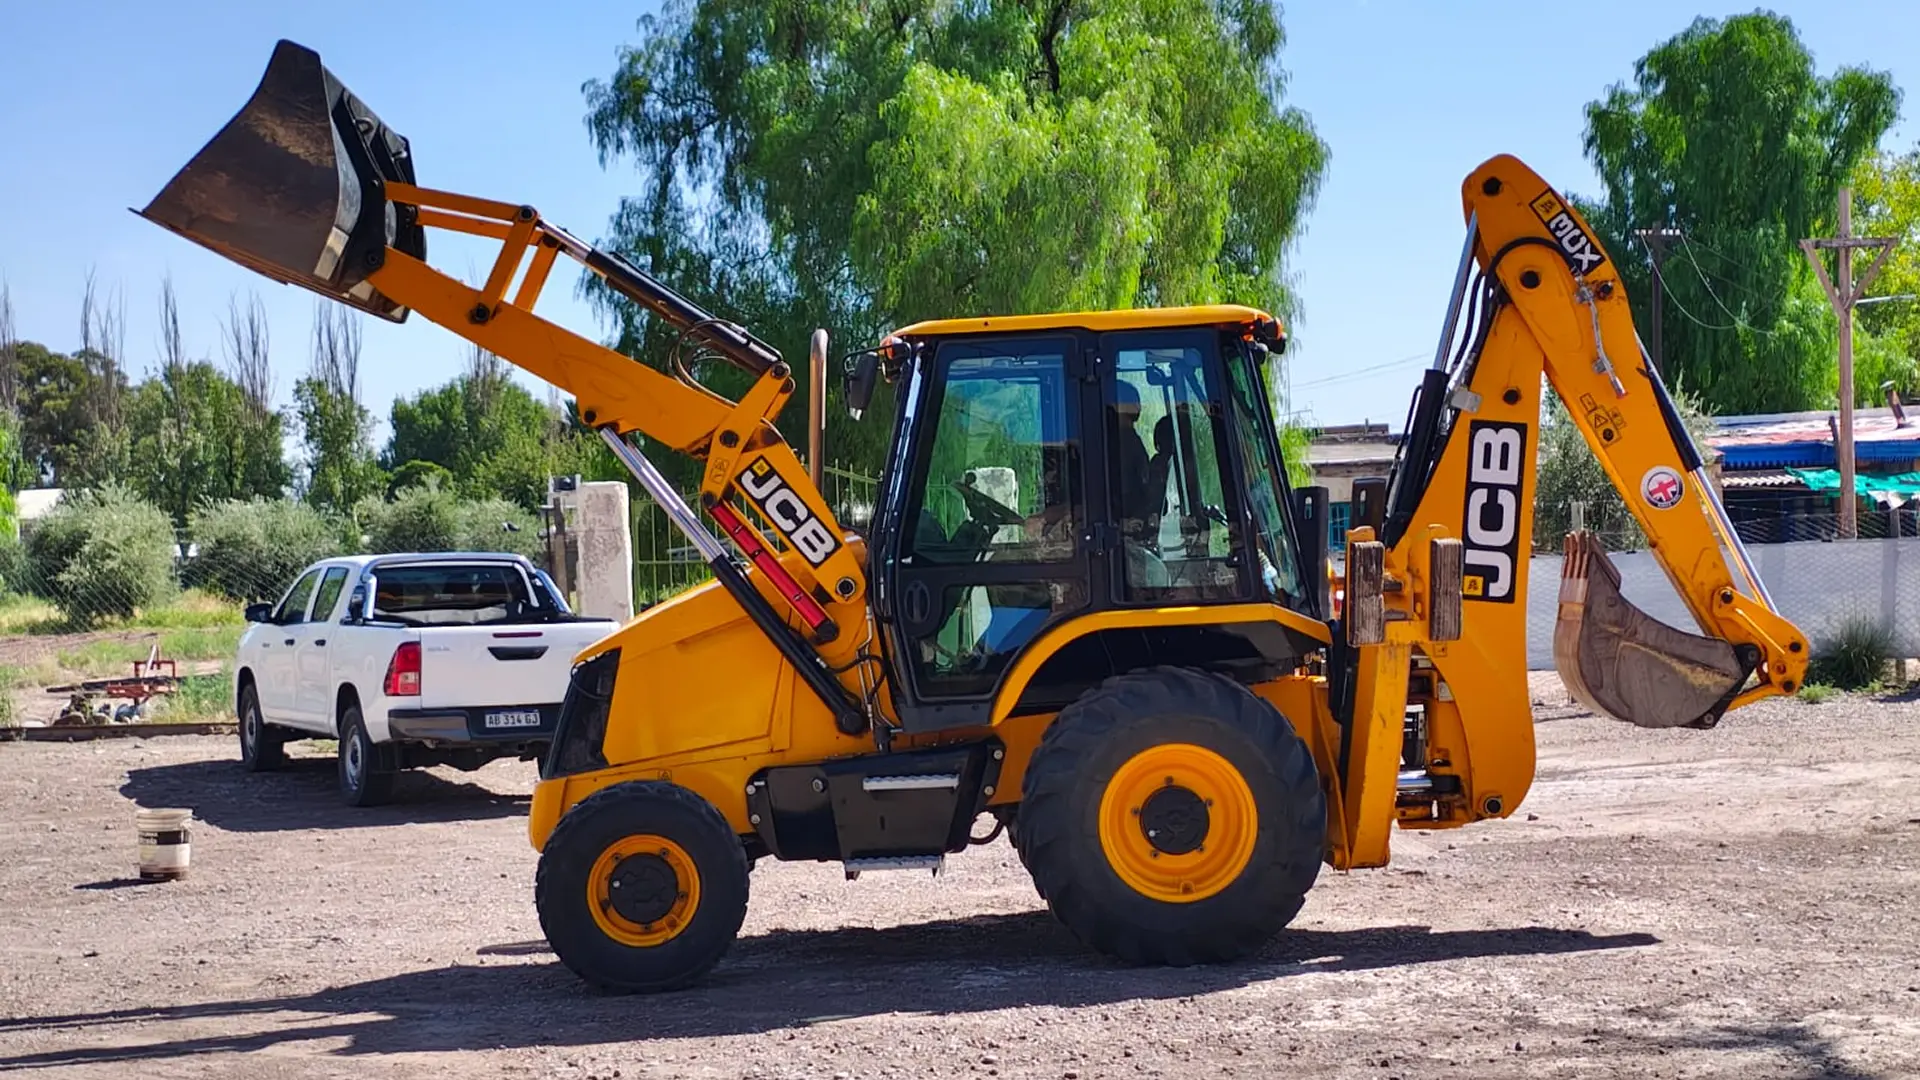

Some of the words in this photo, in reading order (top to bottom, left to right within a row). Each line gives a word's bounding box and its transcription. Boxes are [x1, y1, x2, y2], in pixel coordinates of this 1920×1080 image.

[1549, 212, 1601, 272] 3CX
[741, 469, 836, 563] JCB
[1465, 427, 1521, 597] JCB
[488, 715, 501, 726] AB
